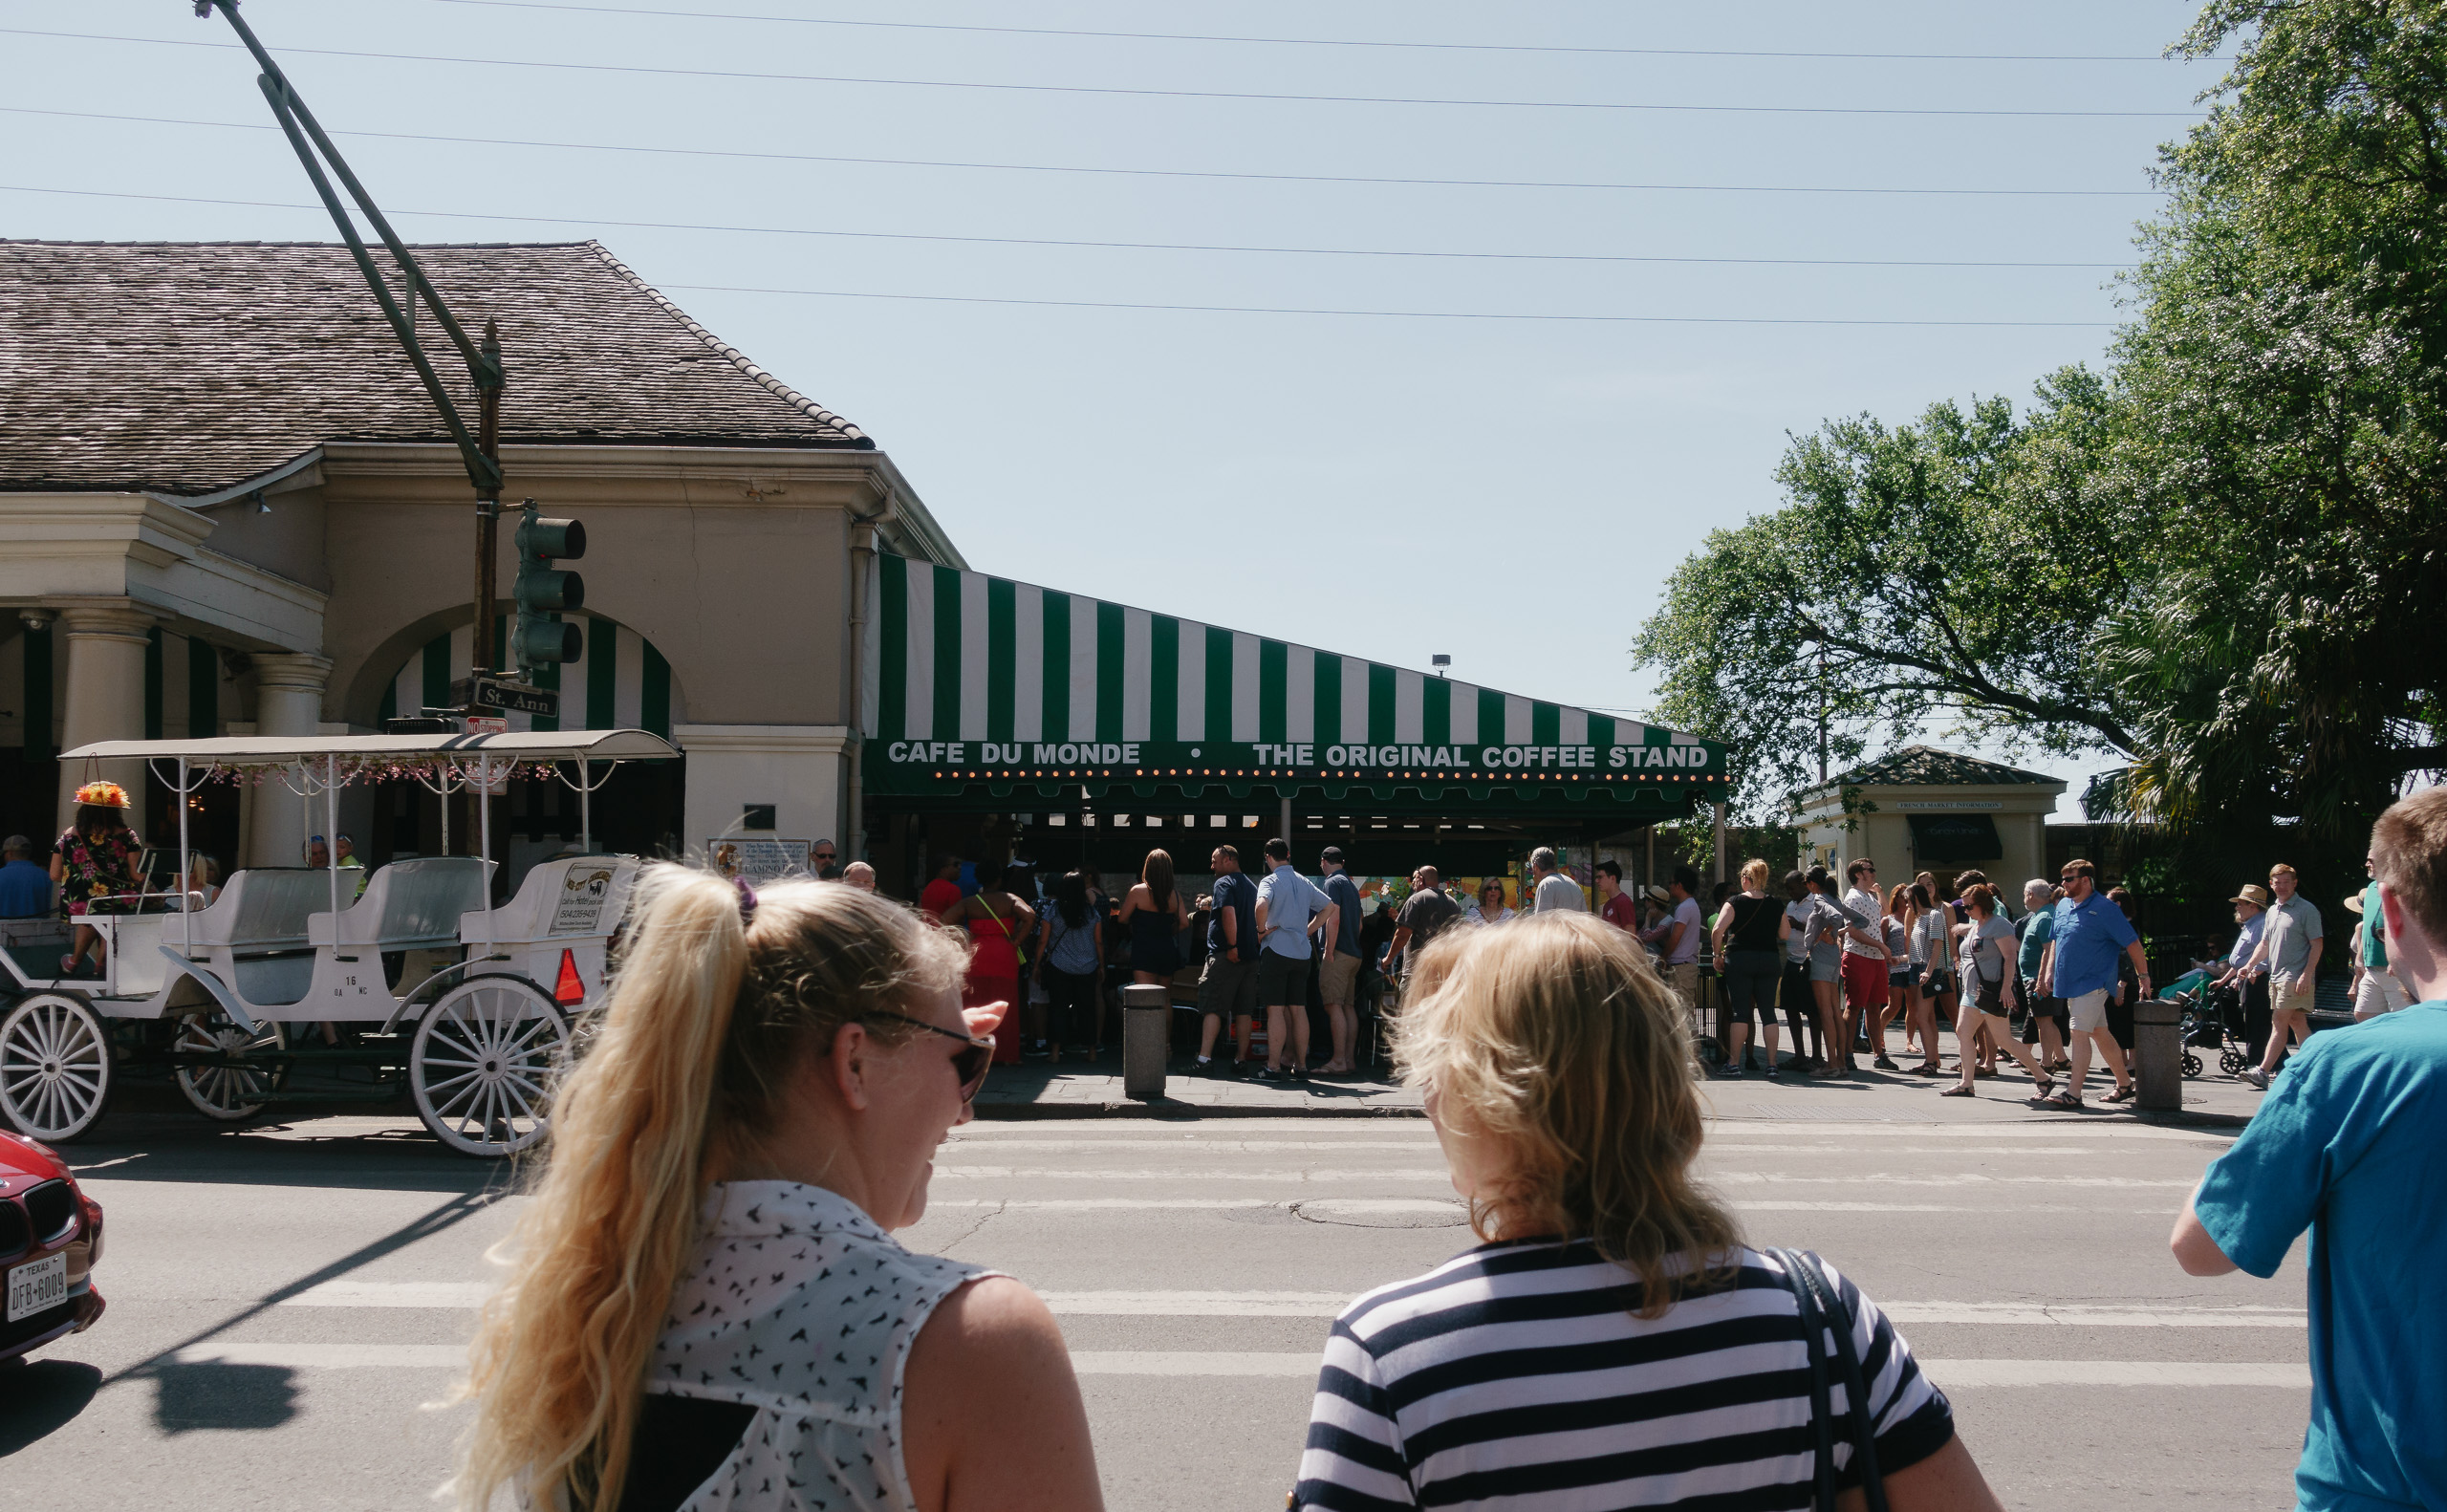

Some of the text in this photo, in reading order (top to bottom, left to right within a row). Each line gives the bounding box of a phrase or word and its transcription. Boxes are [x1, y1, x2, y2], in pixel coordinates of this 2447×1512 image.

[486, 688, 549, 713] St. Ann
[467, 722, 505, 734] NO STOPPING
[888, 742, 1140, 765] CAFE DU MONDE
[1253, 744, 1708, 767] THE ORIGINAL COFFEE STAND
[745, 865, 780, 873] CAMINO
[575, 895, 590, 906] Hotel
[345, 976, 357, 985] 16
[358, 986, 367, 995] NC
[27, 1262, 50, 1276] TEXAS
